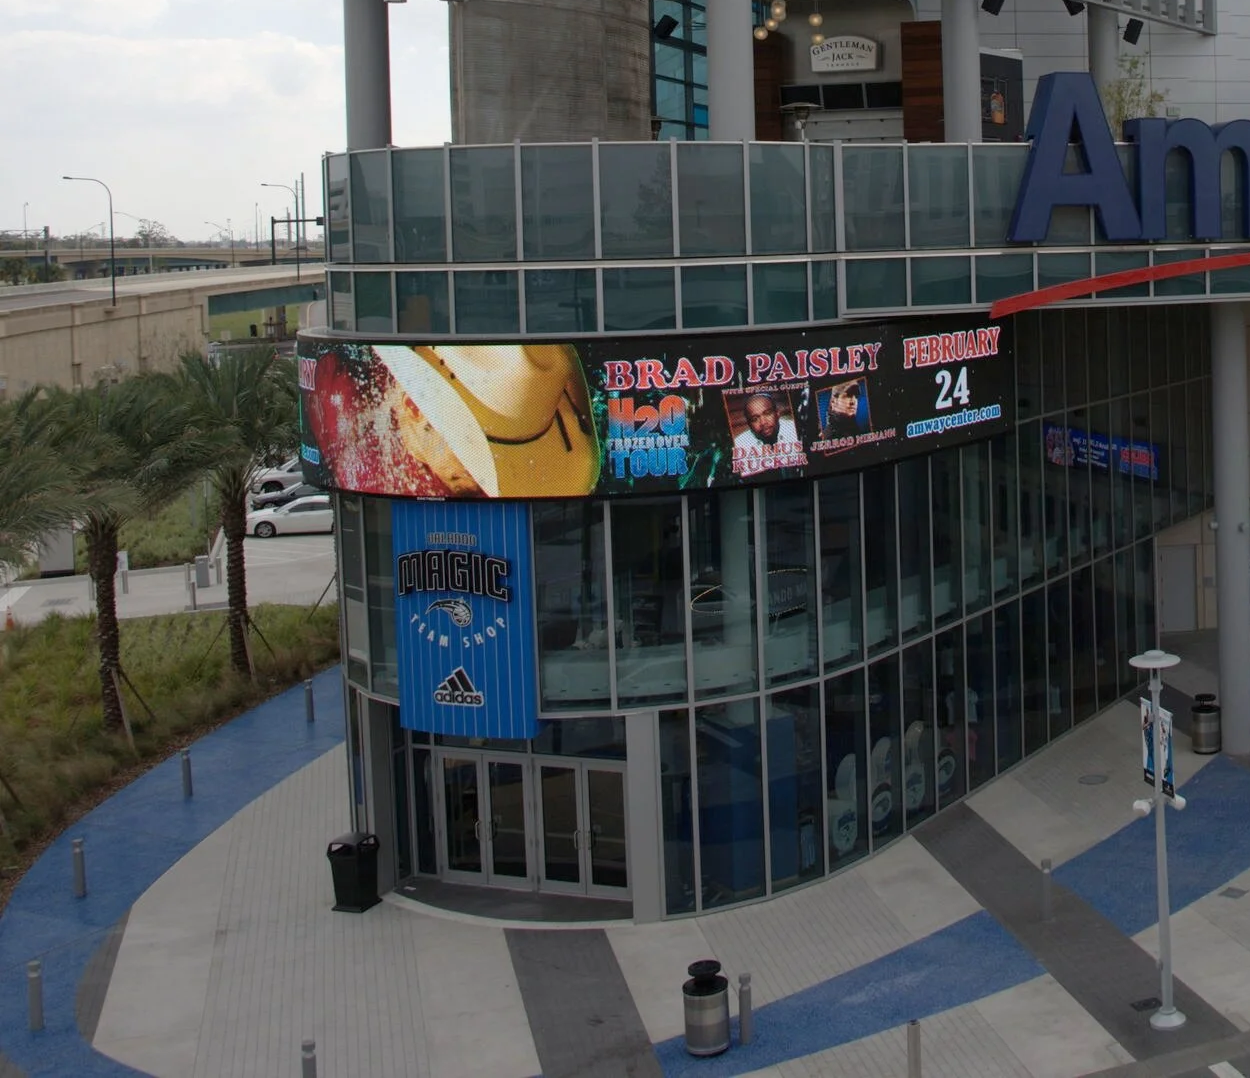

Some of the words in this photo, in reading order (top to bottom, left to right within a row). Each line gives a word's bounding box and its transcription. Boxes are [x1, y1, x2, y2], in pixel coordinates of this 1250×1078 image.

[812, 41, 874, 56] GENTLEMAN
[832, 53, 854, 62] JACK
[903, 326, 1001, 369] FEBRUARY
[603, 355, 735, 391] BRAD
[746, 342, 882, 383] PAISLEY
[935, 366, 971, 410] 24
[607, 394, 687, 439] H2O
[906, 404, 1001, 439] amwaycenter.com
[607, 435, 653, 451] FROZEN
[654, 434, 690, 449] OVER
[732, 441, 803, 460] DARIUS
[810, 435, 855, 452] JERROD
[609, 447, 689, 479] TOUR
[732, 452, 809, 474] RUCKER
[397, 550, 511, 603] MAGIC
[410, 613, 449, 647] TEAM
[463, 617, 506, 648] SHOP
[434, 690, 483, 706] adidas
